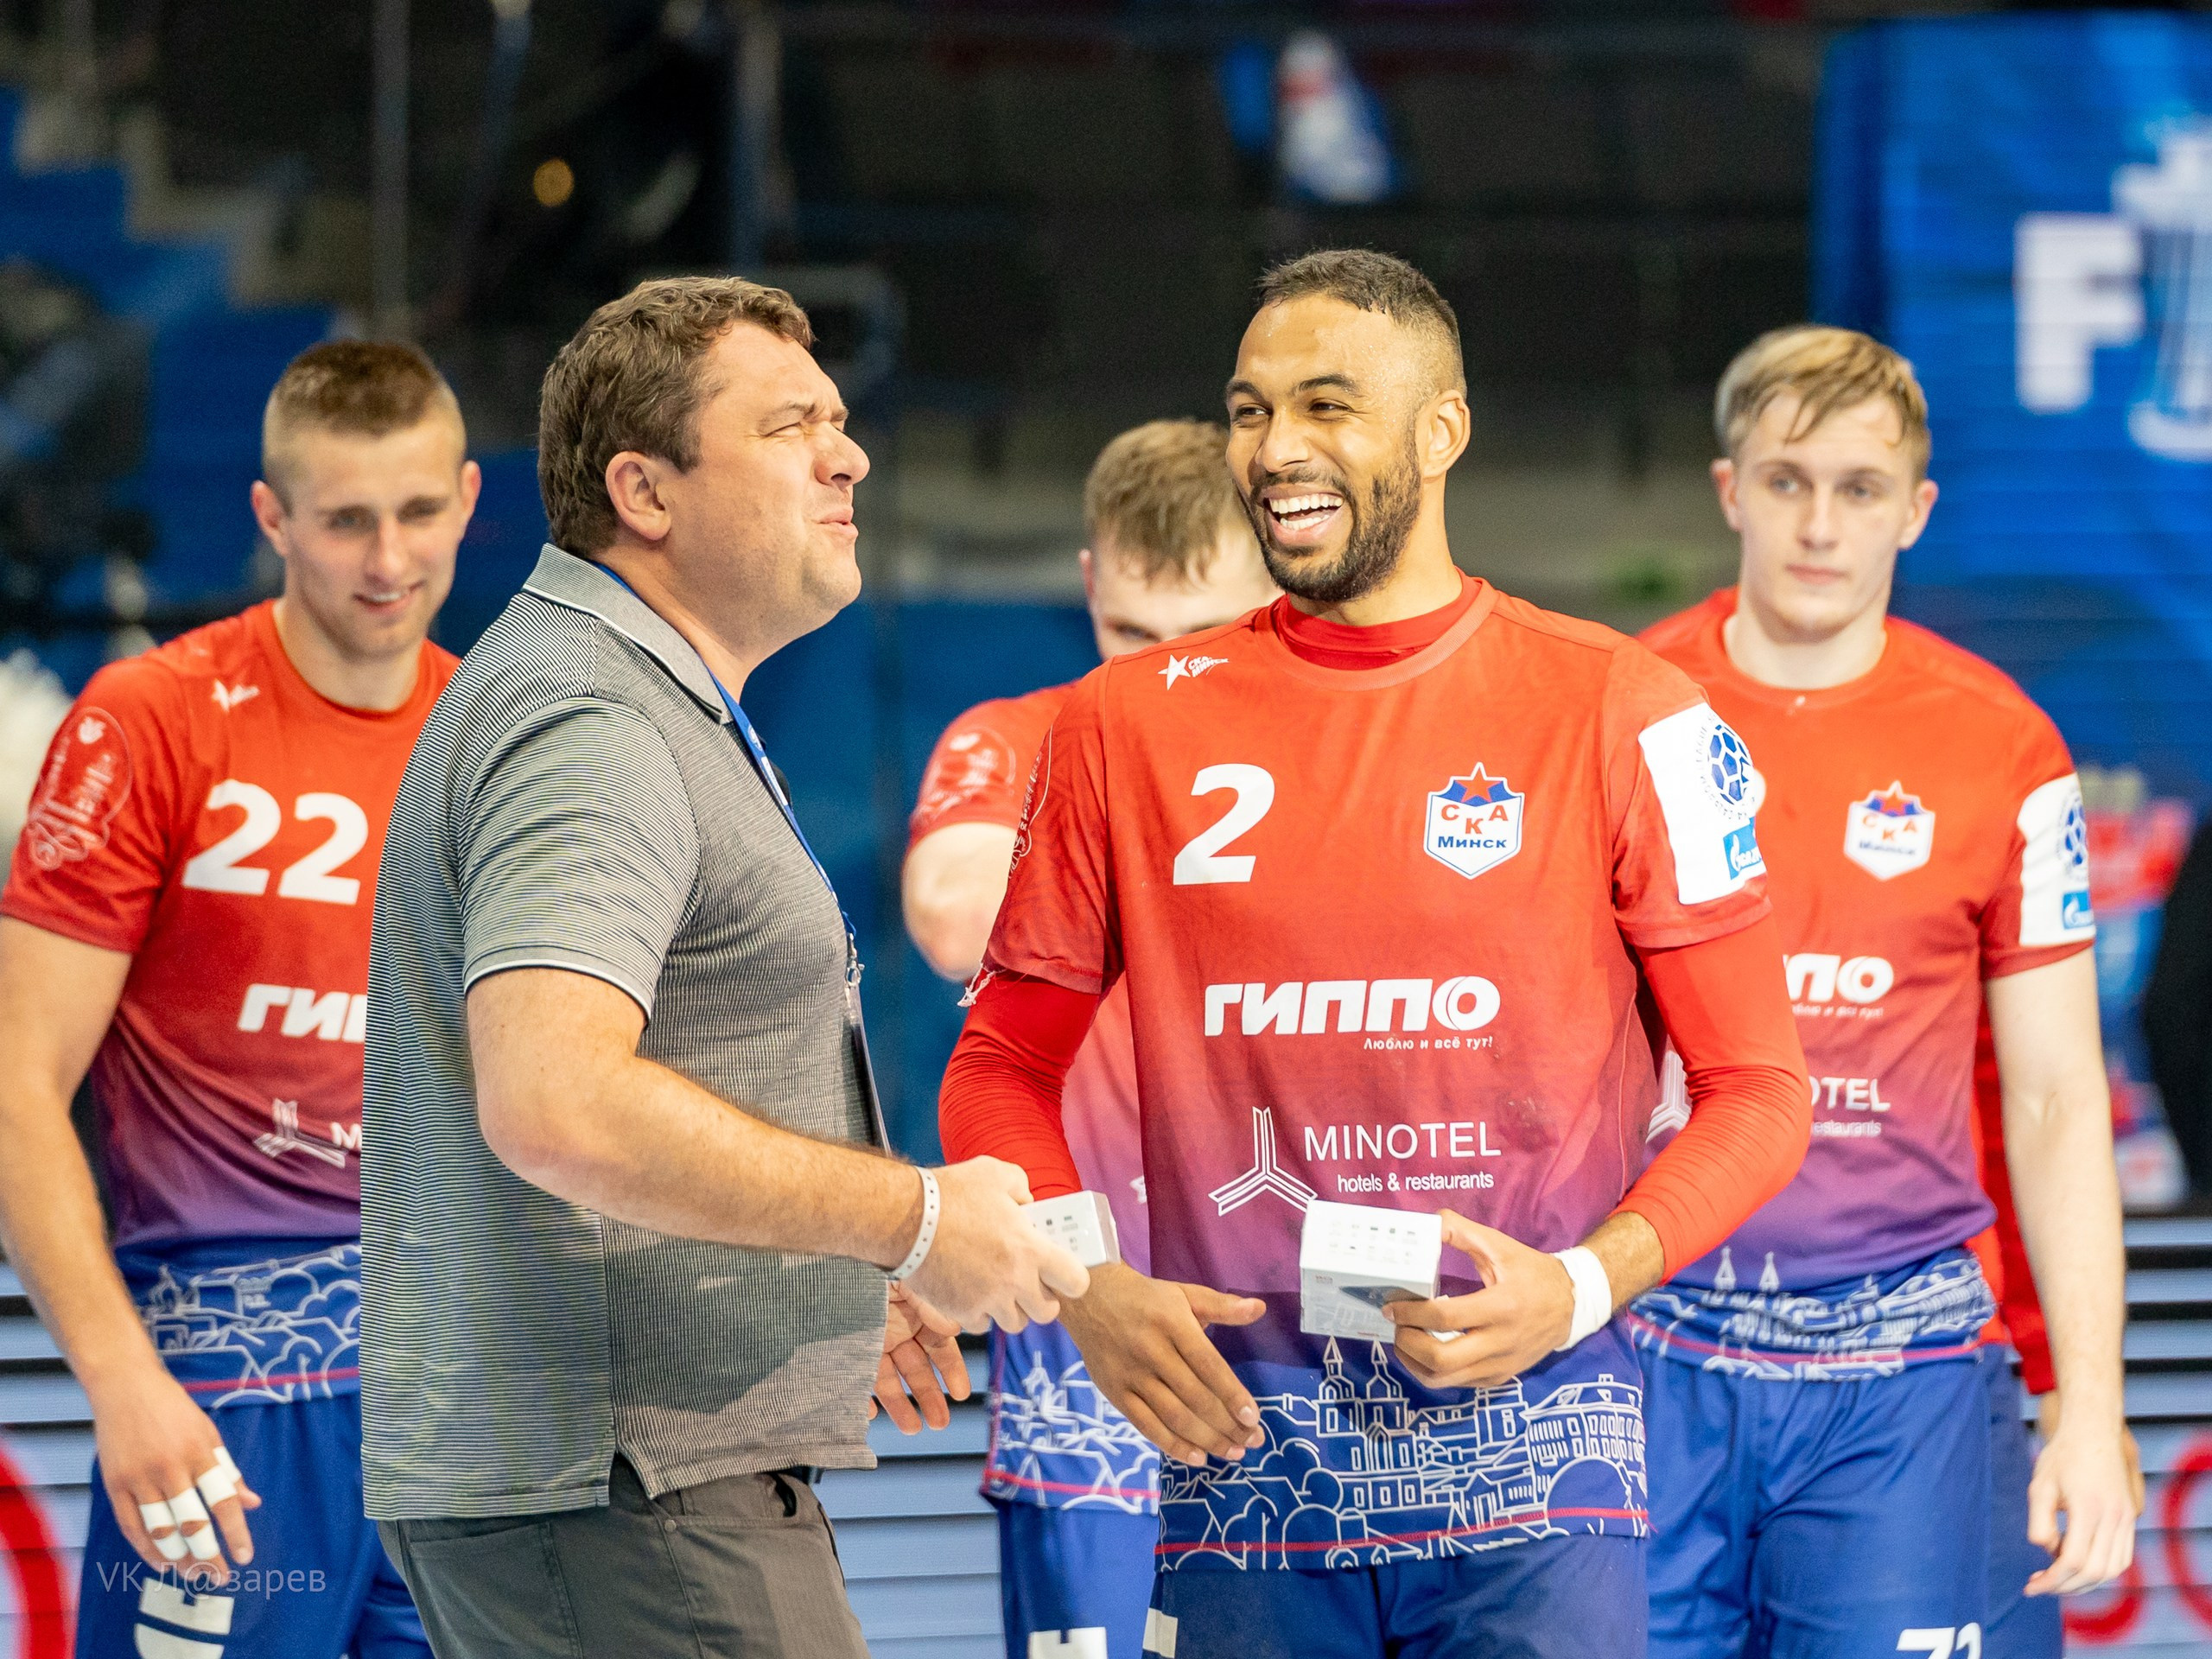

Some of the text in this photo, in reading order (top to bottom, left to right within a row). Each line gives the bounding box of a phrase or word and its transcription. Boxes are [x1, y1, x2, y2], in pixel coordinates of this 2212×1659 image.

[181, 778, 369, 906] 22
[1173, 763, 1275, 886] 2
[1437, 836, 1507, 849] Минск
[1783, 952, 1894, 1004] ПО
[1205, 976, 1501, 1036] ГИППО
[1363, 1036, 1493, 1050] Люблю и всё тут!
[1304, 1122, 1502, 1161] MINOTEL
[1812, 1119, 1882, 1137] estaurants
[1338, 1171, 1494, 1192] hotels & restaurants
